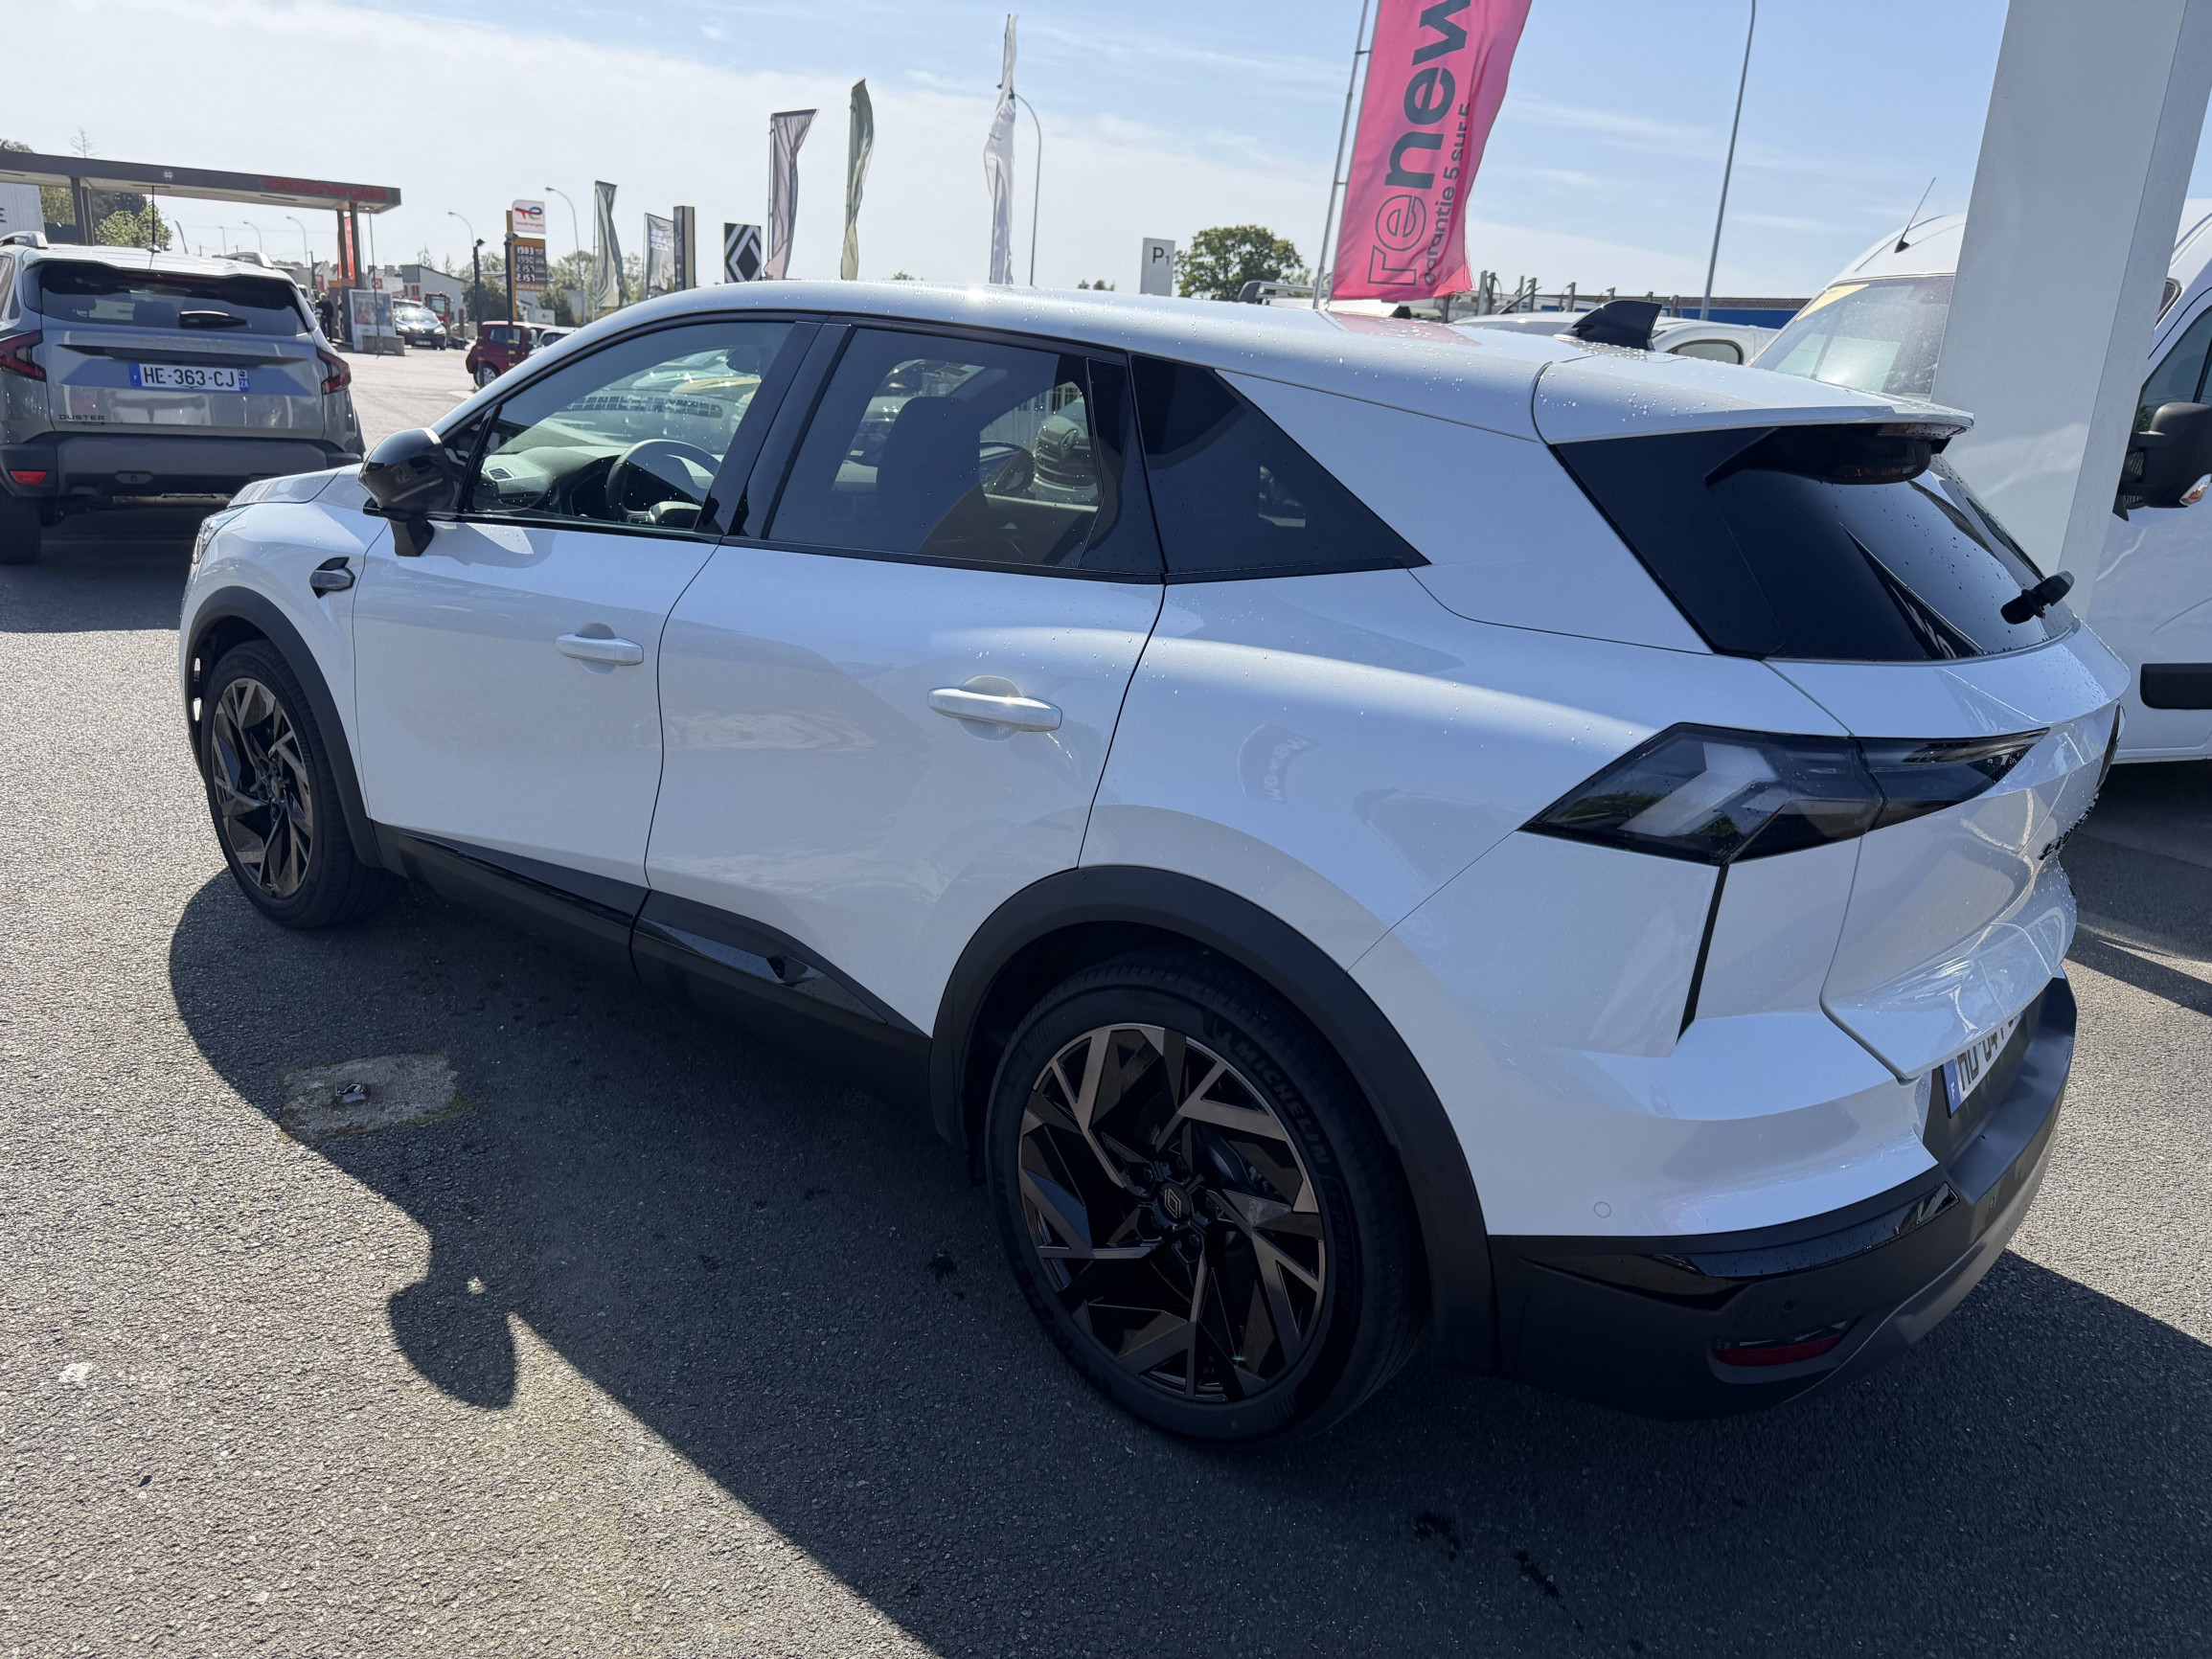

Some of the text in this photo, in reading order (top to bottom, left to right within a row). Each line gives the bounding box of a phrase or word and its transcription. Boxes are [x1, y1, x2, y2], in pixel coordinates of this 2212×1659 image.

[1368, 0, 1471, 285] renew
[1443, 167, 1460, 181] 5
[1451, 122, 1468, 162] sur
[1424, 186, 1455, 286] garantie
[143, 367, 236, 388] HE-363-CJ
[1234, 1040, 1331, 1164] MICHELIN
